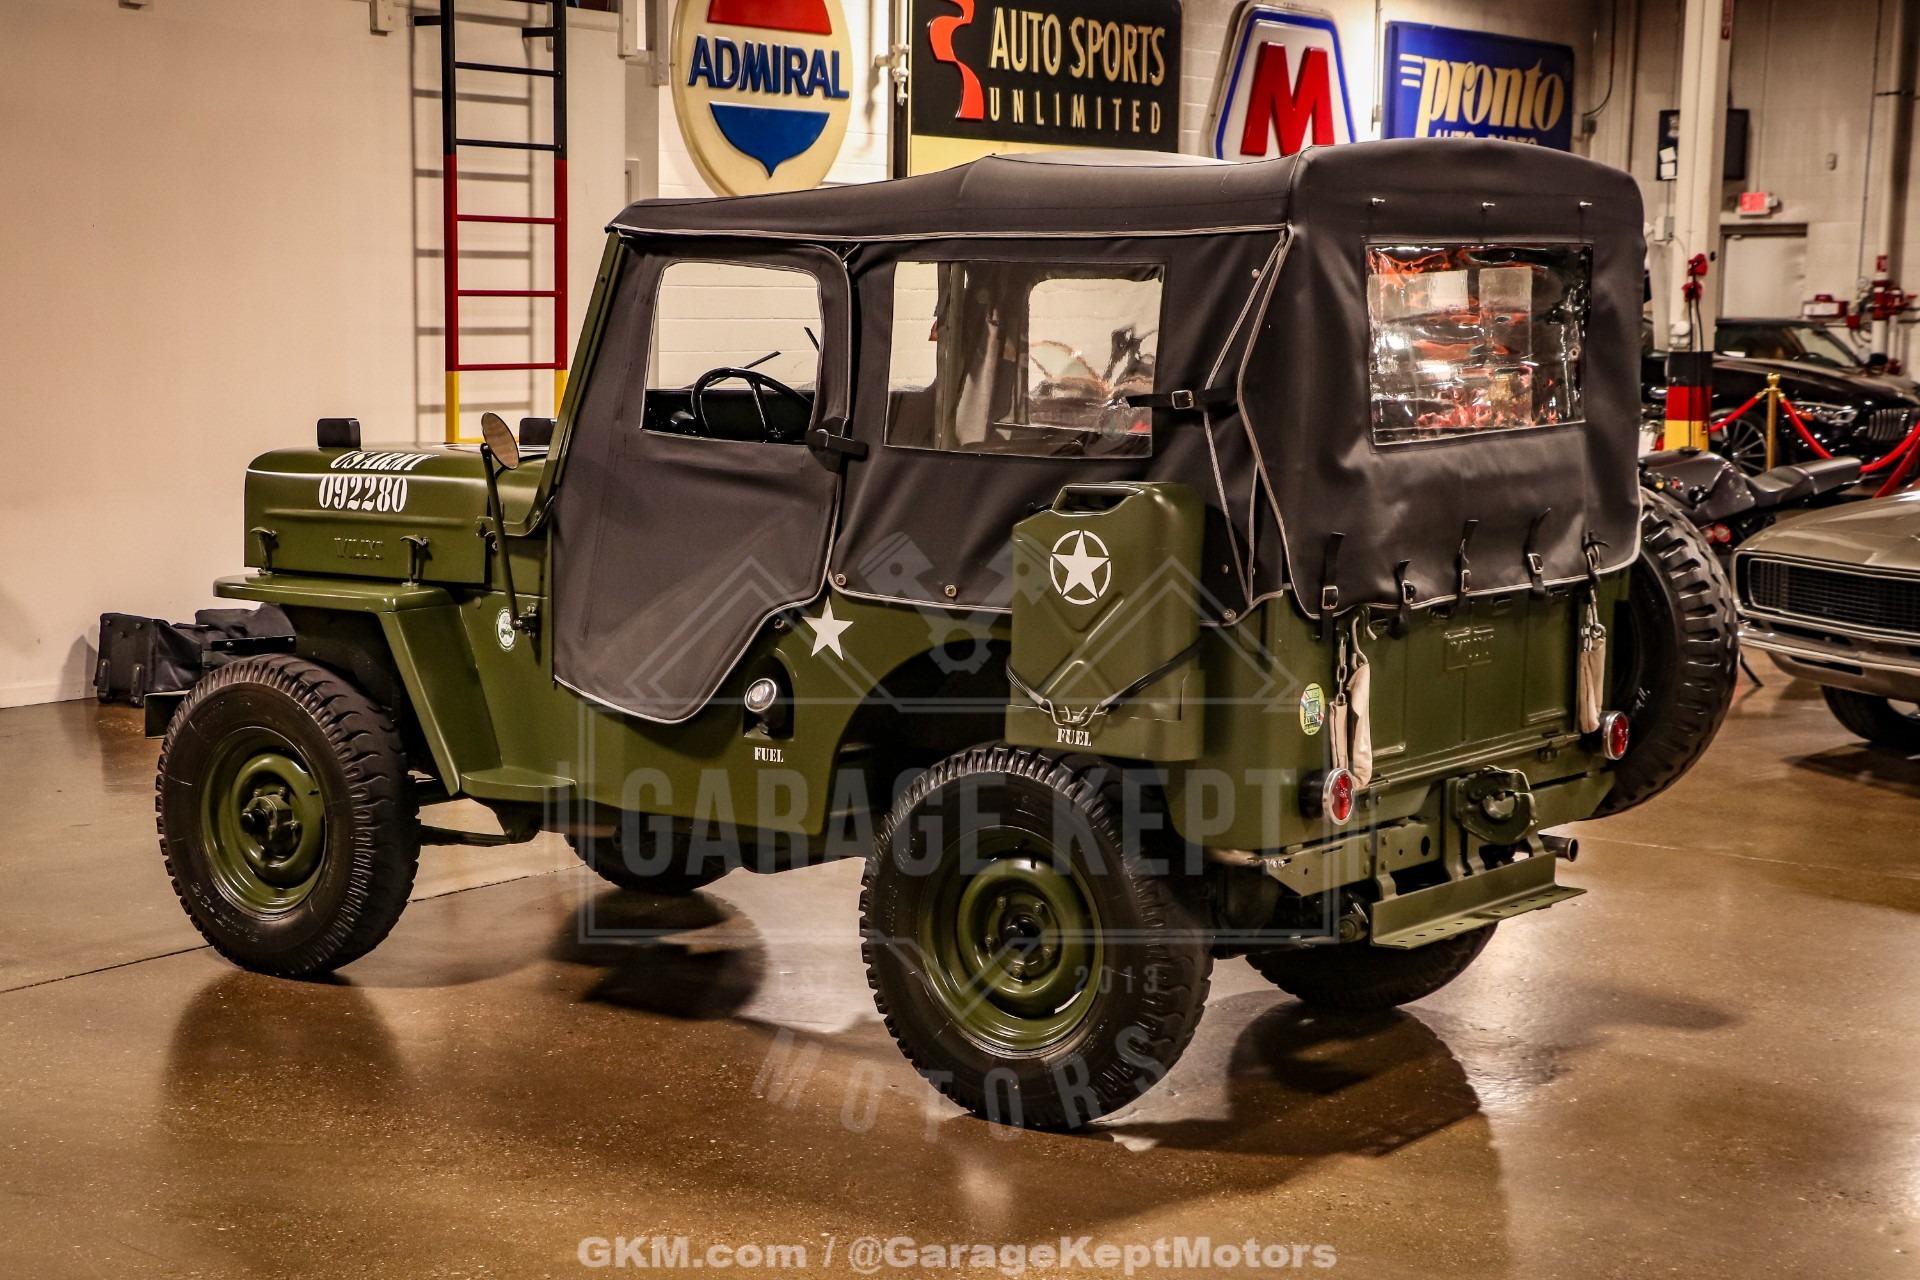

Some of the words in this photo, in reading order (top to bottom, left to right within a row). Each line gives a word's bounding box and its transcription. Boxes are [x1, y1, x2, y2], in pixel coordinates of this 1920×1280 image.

[687, 33, 850, 100] ADMIRAL
[990, 7, 1063, 76] AUTO
[1069, 16, 1166, 87] SPORTS
[989, 86, 1162, 135] UNLIMITED
[1240, 40, 1336, 156] M
[1414, 56, 1565, 138] pronto
[318, 475, 408, 513] 092280
[753, 746, 784, 763] FUEL
[1056, 728, 1093, 748] FUEL
